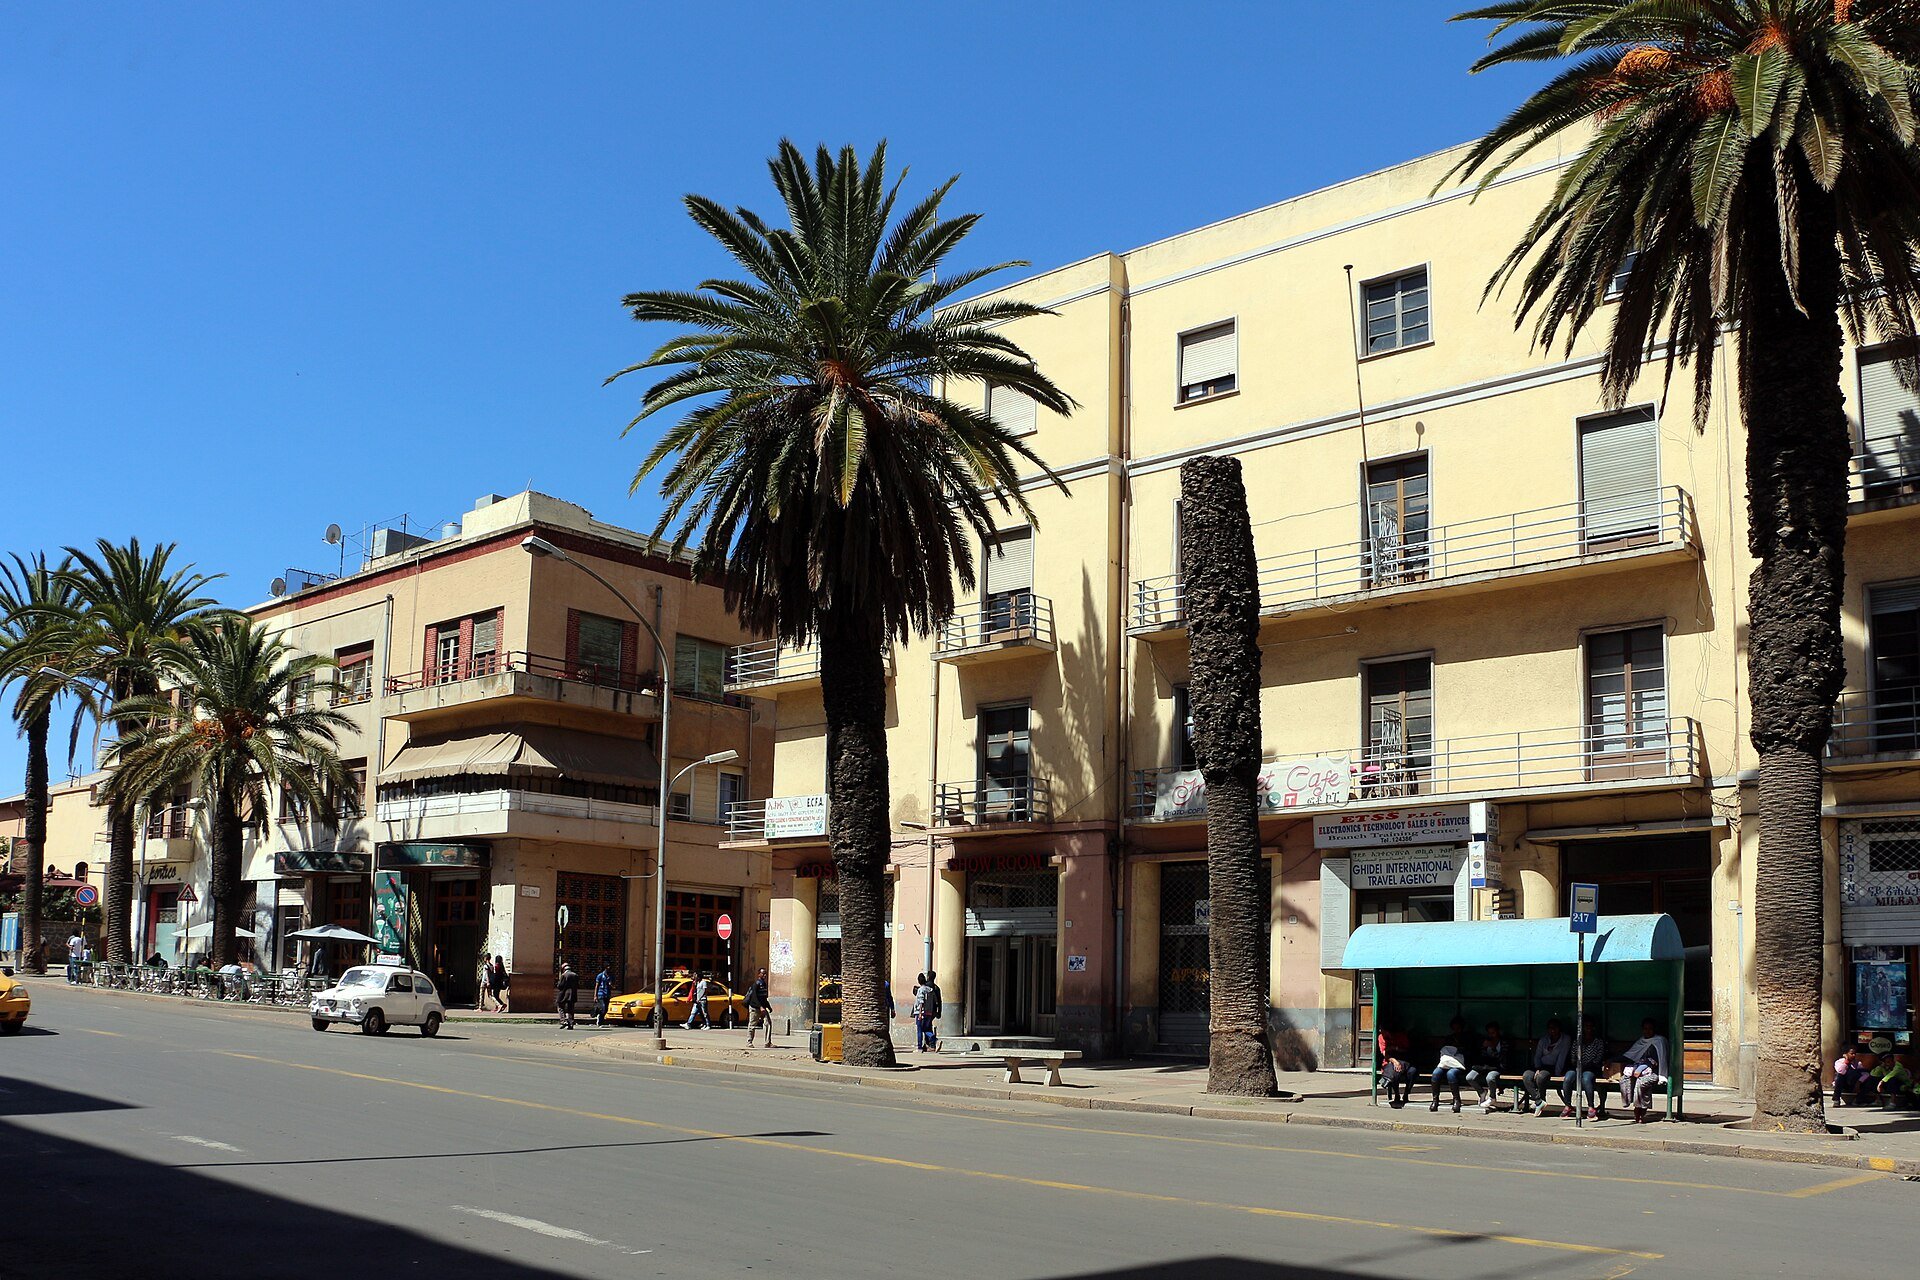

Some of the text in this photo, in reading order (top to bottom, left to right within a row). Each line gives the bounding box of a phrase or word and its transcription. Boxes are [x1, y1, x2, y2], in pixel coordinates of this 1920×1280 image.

[1286, 765, 1341, 797] Cafe
[1407, 811, 1446, 819] P.L.C.
[1318, 816, 1470, 835] ELECTRONICS TECHNOLOGY SALES & SERVICES
[1328, 833, 1367, 841] Branch
[949, 848, 1041, 873] SHOW ROOM
[1353, 861, 1453, 875] GHIDEI INTERNATIONAL
[1846, 834, 1855, 902] BINDING
[1368, 873, 1438, 886] TRAVEL AGENCY
